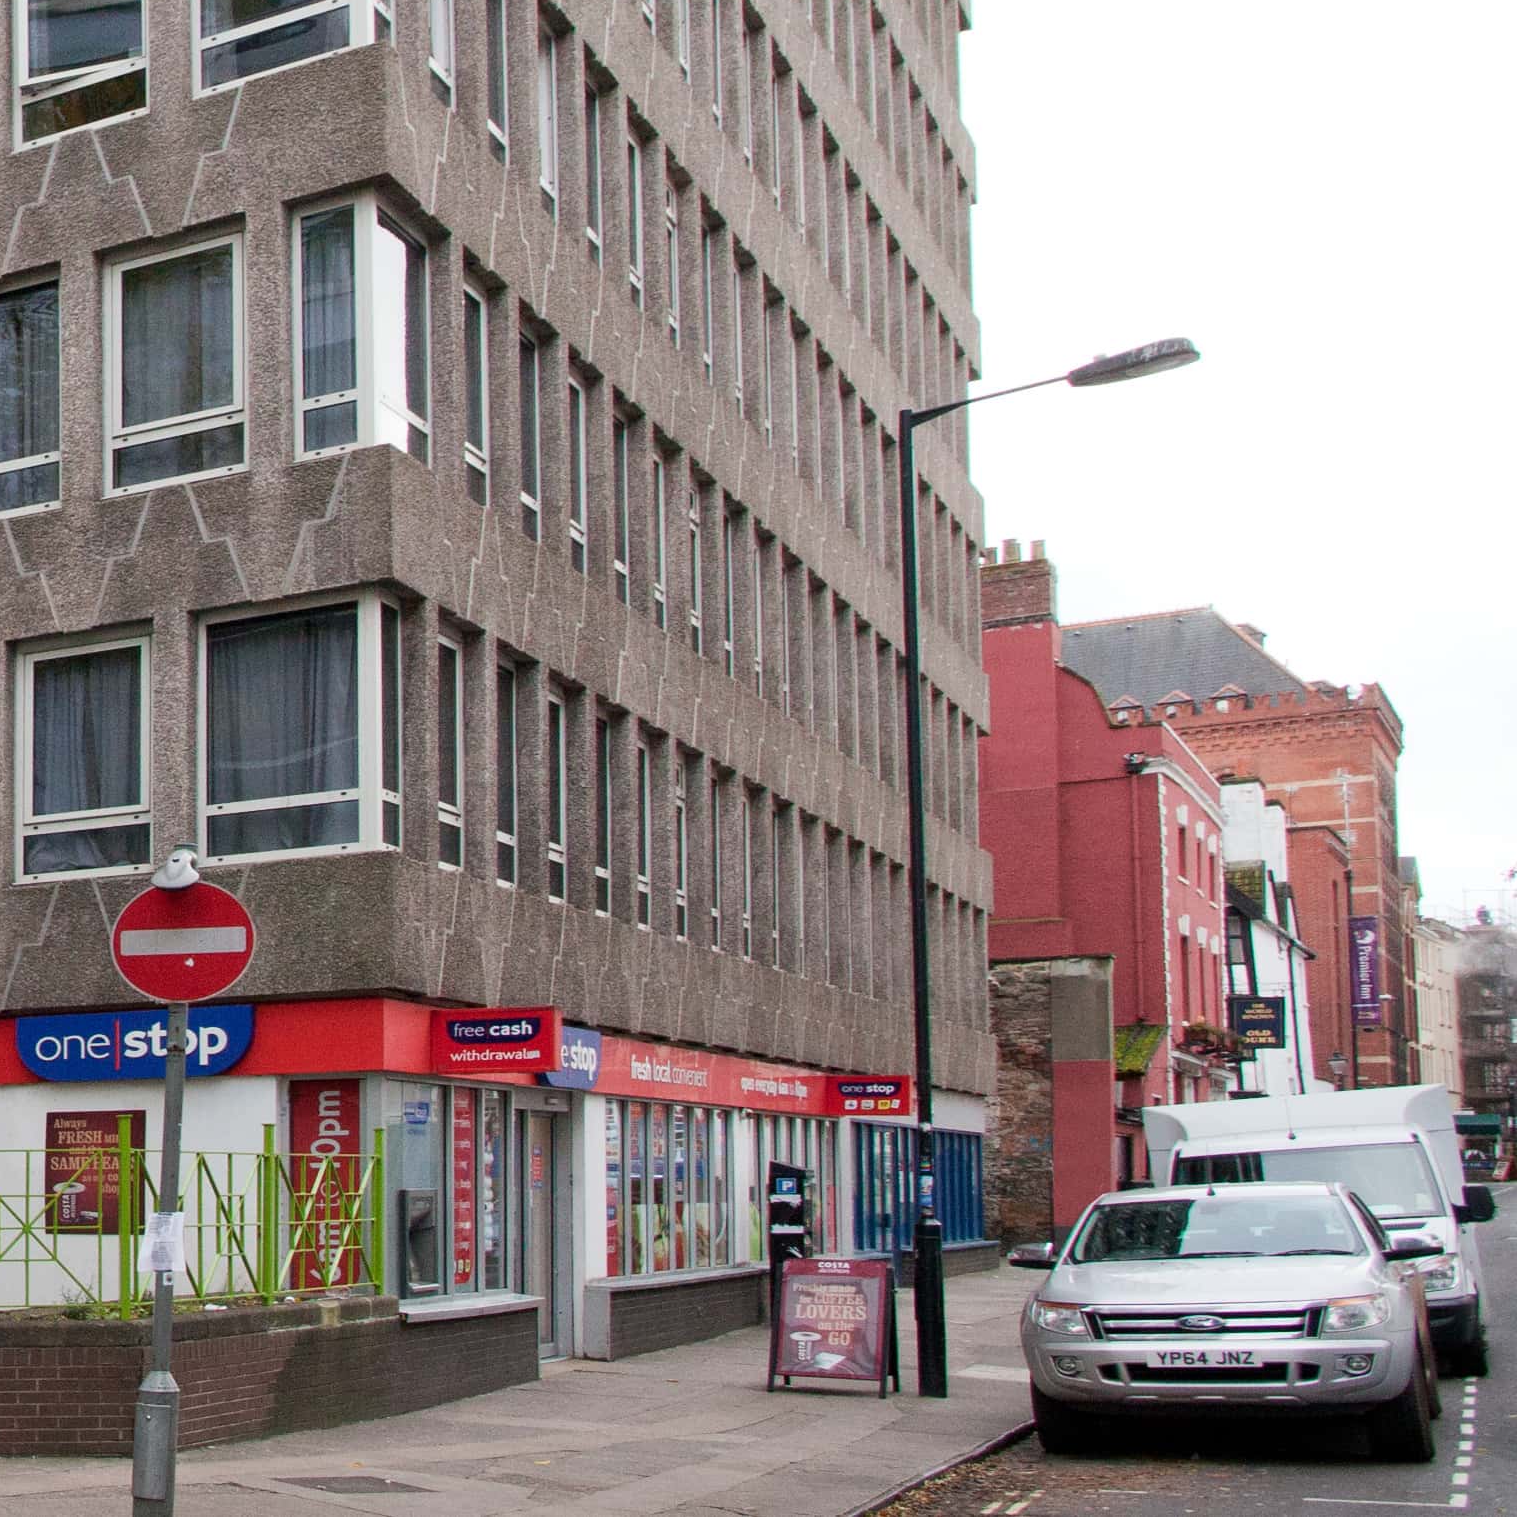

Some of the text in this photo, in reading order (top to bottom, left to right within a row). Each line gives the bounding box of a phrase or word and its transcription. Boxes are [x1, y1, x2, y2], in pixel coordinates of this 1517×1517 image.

[1358, 946, 1373, 983] Premier
[1360, 984, 1373, 999] Inn
[453, 1020, 533, 1037] free cash
[35, 1033, 111, 1061] one
[450, 1047, 541, 1062] withdrawal
[571, 1039, 596, 1081] stop
[630, 1054, 650, 1082] fresh
[841, 1083, 895, 1096] one stop
[54, 1118, 87, 1130] Always
[58, 1131, 103, 1144] FRESH
[62, 1194, 71, 1219] COSTA
[818, 1261, 850, 1269] COSTA
[814, 1292, 864, 1305] COFFEE
[795, 1304, 867, 1320] LOVERS
[835, 1321, 854, 1331] the
[827, 1332, 851, 1346] GO
[1157, 1351, 1255, 1365] YP64 JNZ
